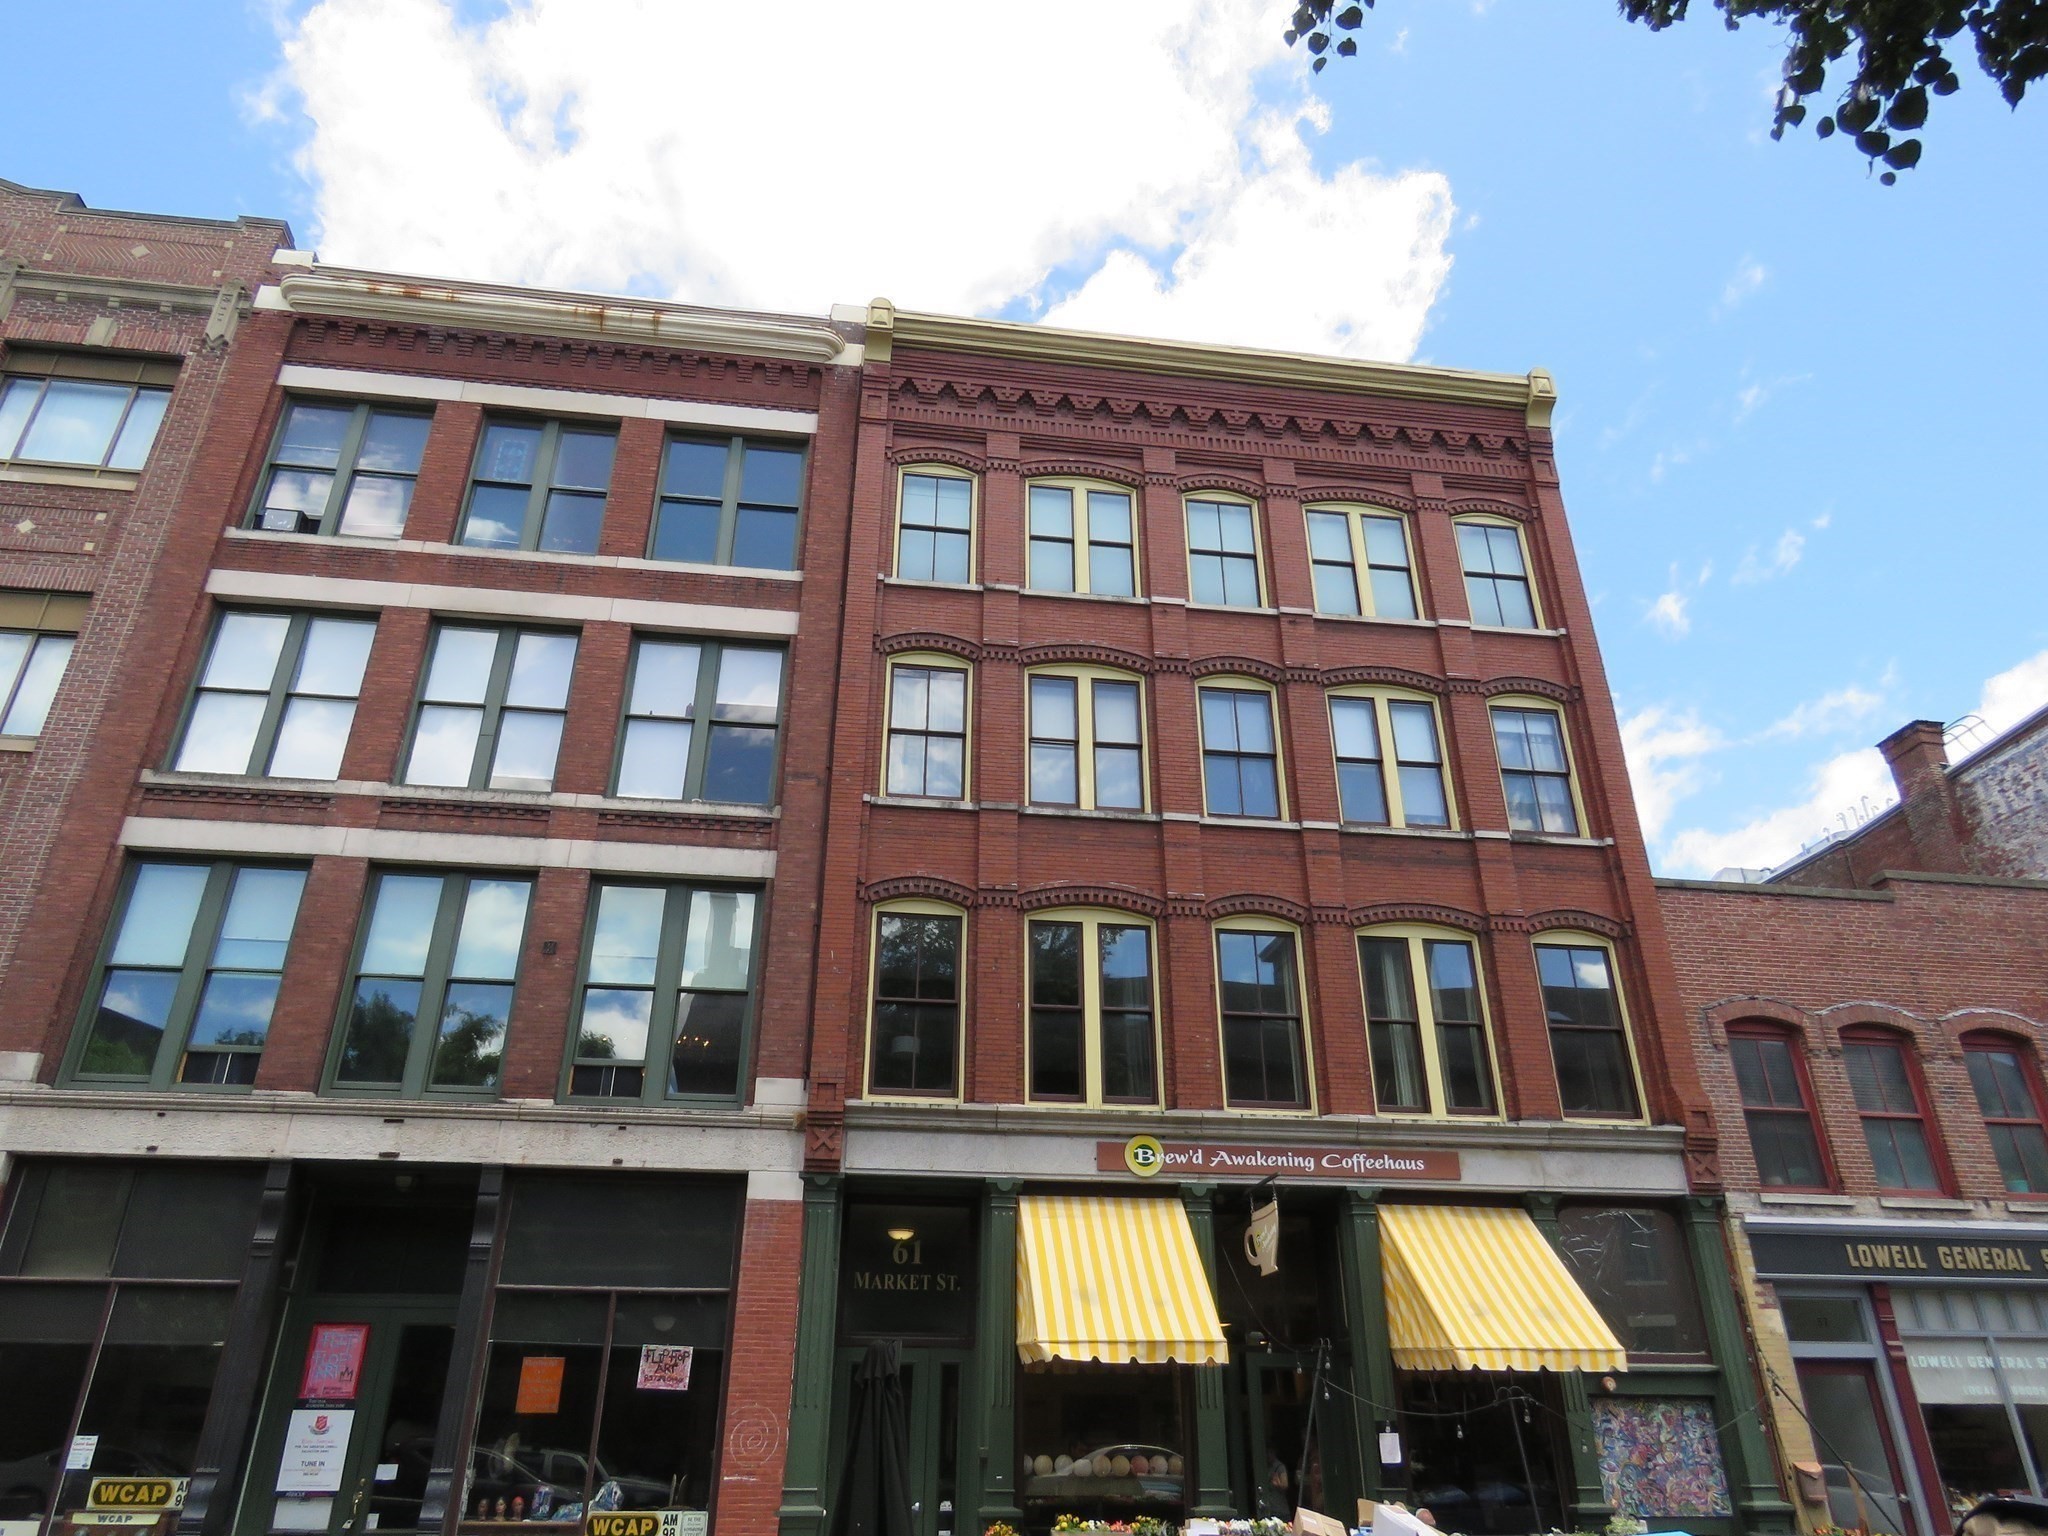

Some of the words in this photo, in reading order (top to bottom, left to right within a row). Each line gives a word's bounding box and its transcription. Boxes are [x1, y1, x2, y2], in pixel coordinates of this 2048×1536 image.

[1134, 1147, 1203, 1165] Brew'd
[1208, 1150, 1315, 1172] Awakening
[1320, 1153, 1425, 1173] Coffeehaus
[892, 1239, 923, 1265] 61
[1845, 1243, 1928, 1270] LOWELL
[1936, 1245, 2032, 1272] GENERAL
[853, 1271, 932, 1291] MARKET
[1909, 1355, 1963, 1369] LOWELL
[99, 1484, 168, 1503] WCAP
[97, 1514, 134, 1524] WCAP
[592, 1518, 654, 1536] WCAP
[662, 1513, 678, 1527] AM
